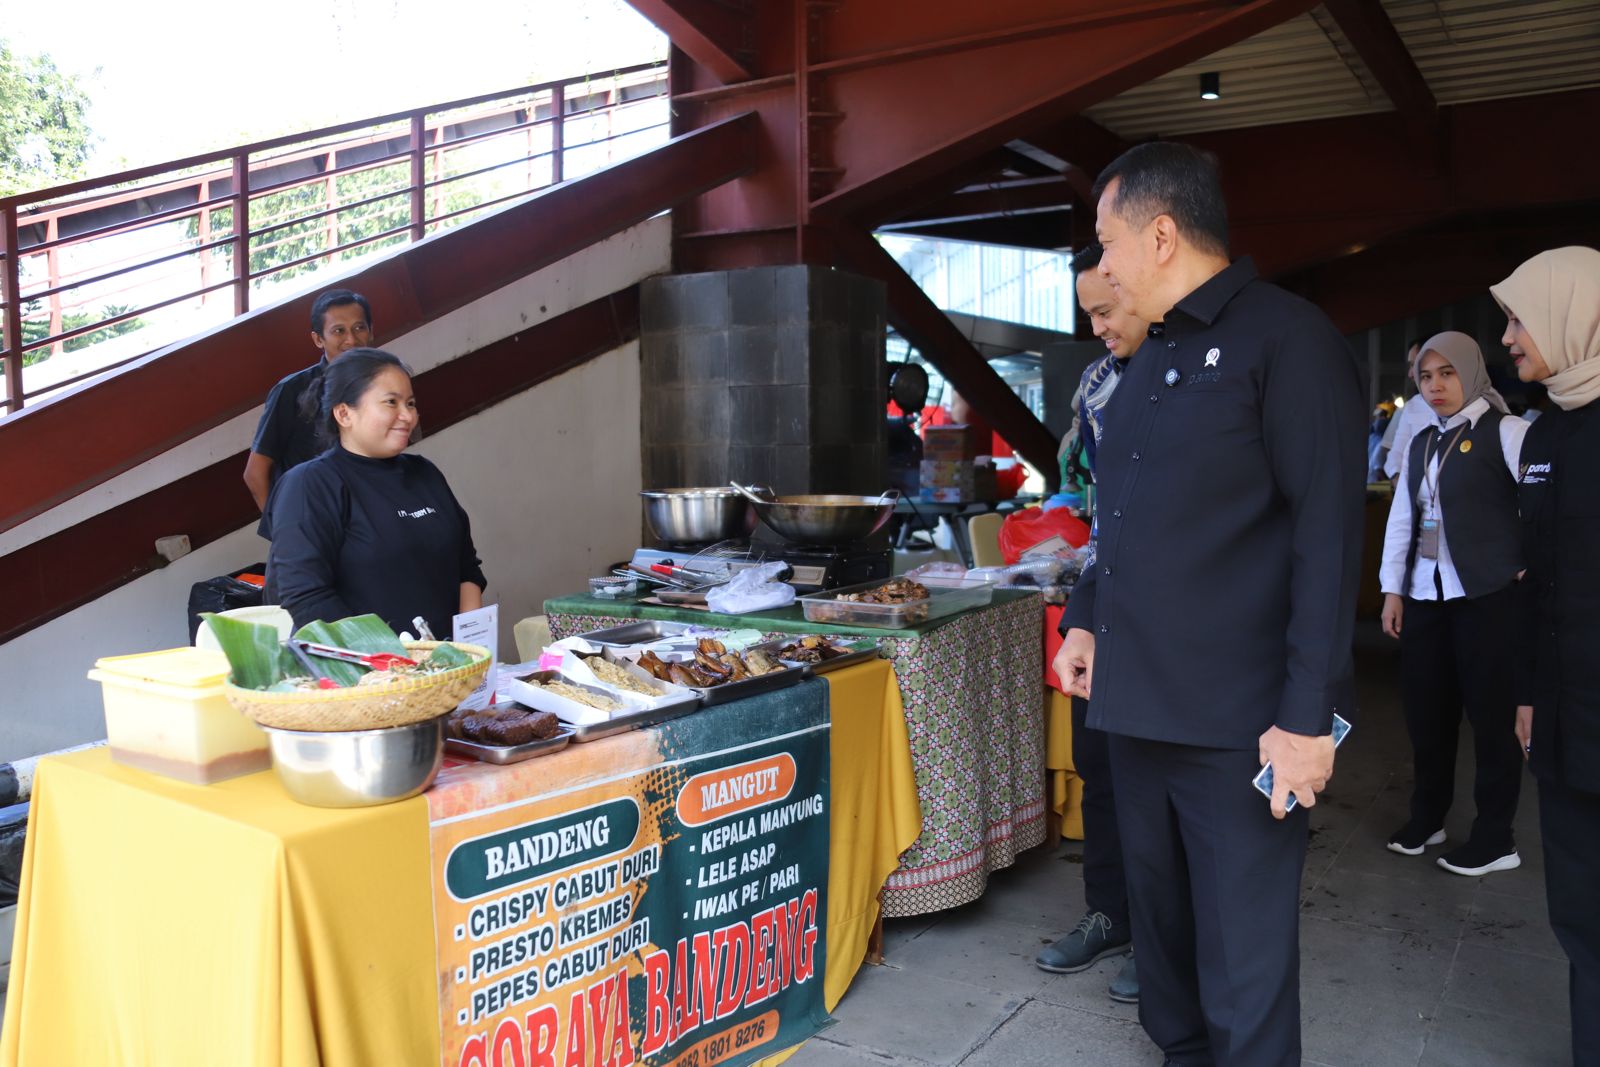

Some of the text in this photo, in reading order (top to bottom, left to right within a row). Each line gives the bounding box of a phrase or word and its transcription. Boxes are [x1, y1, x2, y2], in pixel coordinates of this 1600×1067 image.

[1526, 462, 1551, 475] panrb
[701, 767, 779, 812] MANGUT
[485, 815, 611, 880] BANDENG
[701, 794, 823, 855] KEPALA MANYUNG
[471, 846, 658, 937] CRISPY CABUT DURI
[694, 891, 738, 921] IWAK
[742, 880, 759, 906] PE
[769, 864, 800, 895] PARI
[698, 843, 776, 888] LELE ASAP
[472, 894, 631, 979] PRESTO KREMES
[473, 921, 648, 1020] PEPES CABUT DURI
[642, 888, 818, 1059] BANDENG
[703, 1034, 731, 1063] 1801
[735, 1020, 765, 1048] 8276
